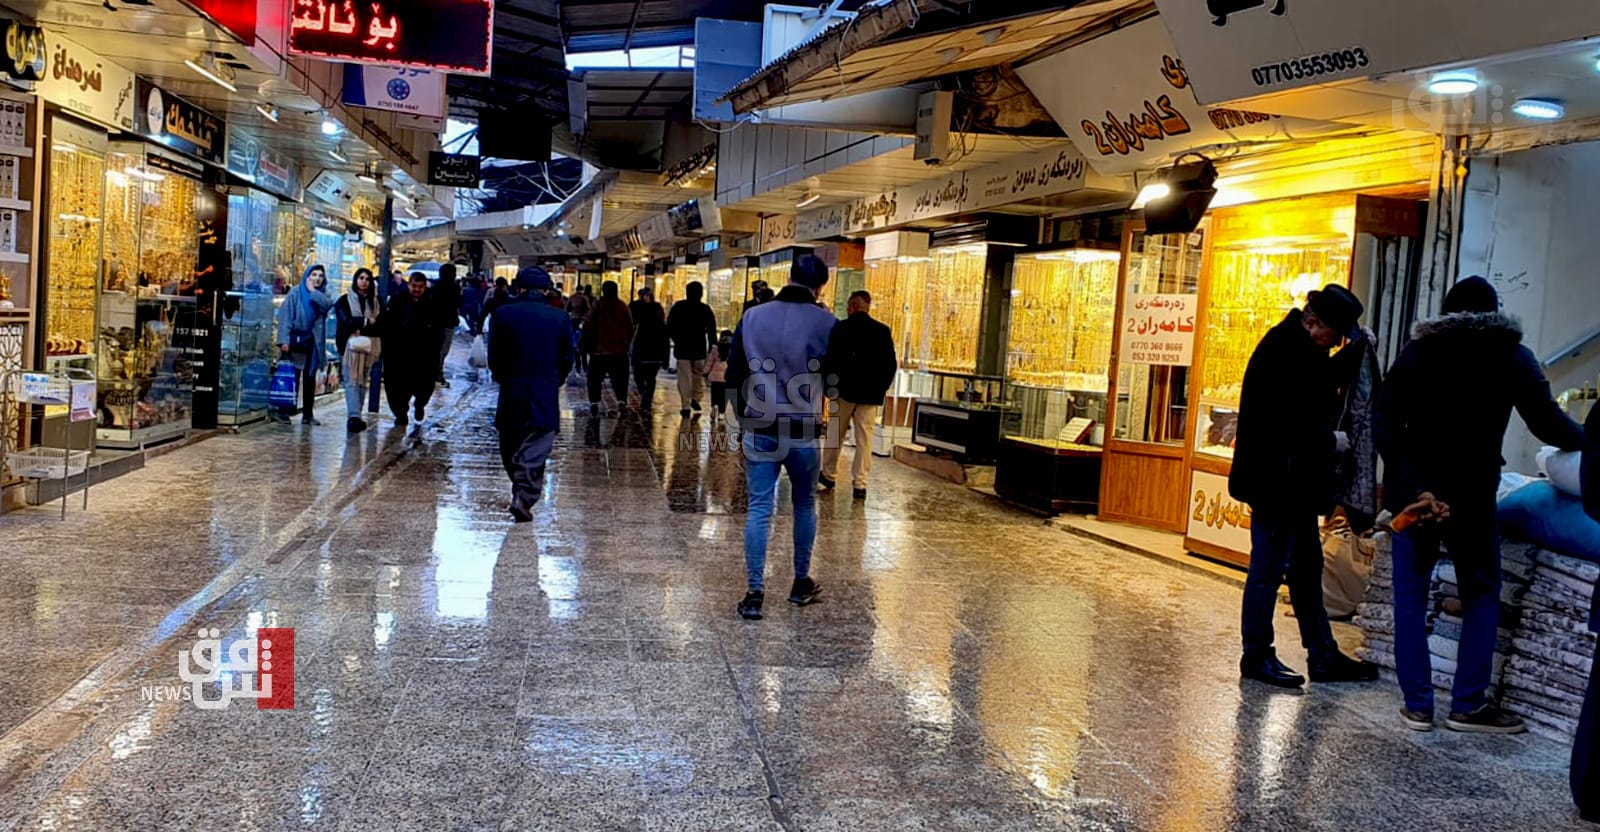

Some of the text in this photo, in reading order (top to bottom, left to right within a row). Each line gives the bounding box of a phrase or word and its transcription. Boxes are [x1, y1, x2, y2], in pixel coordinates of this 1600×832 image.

[292, 0, 398, 50] بۆ ئالت
[1251, 47, 1369, 86] 07703553093
[1081, 94, 1191, 156] کامەران 2
[1127, 315, 1194, 335] کامەران 2
[1193, 489, 1206, 522] 2
